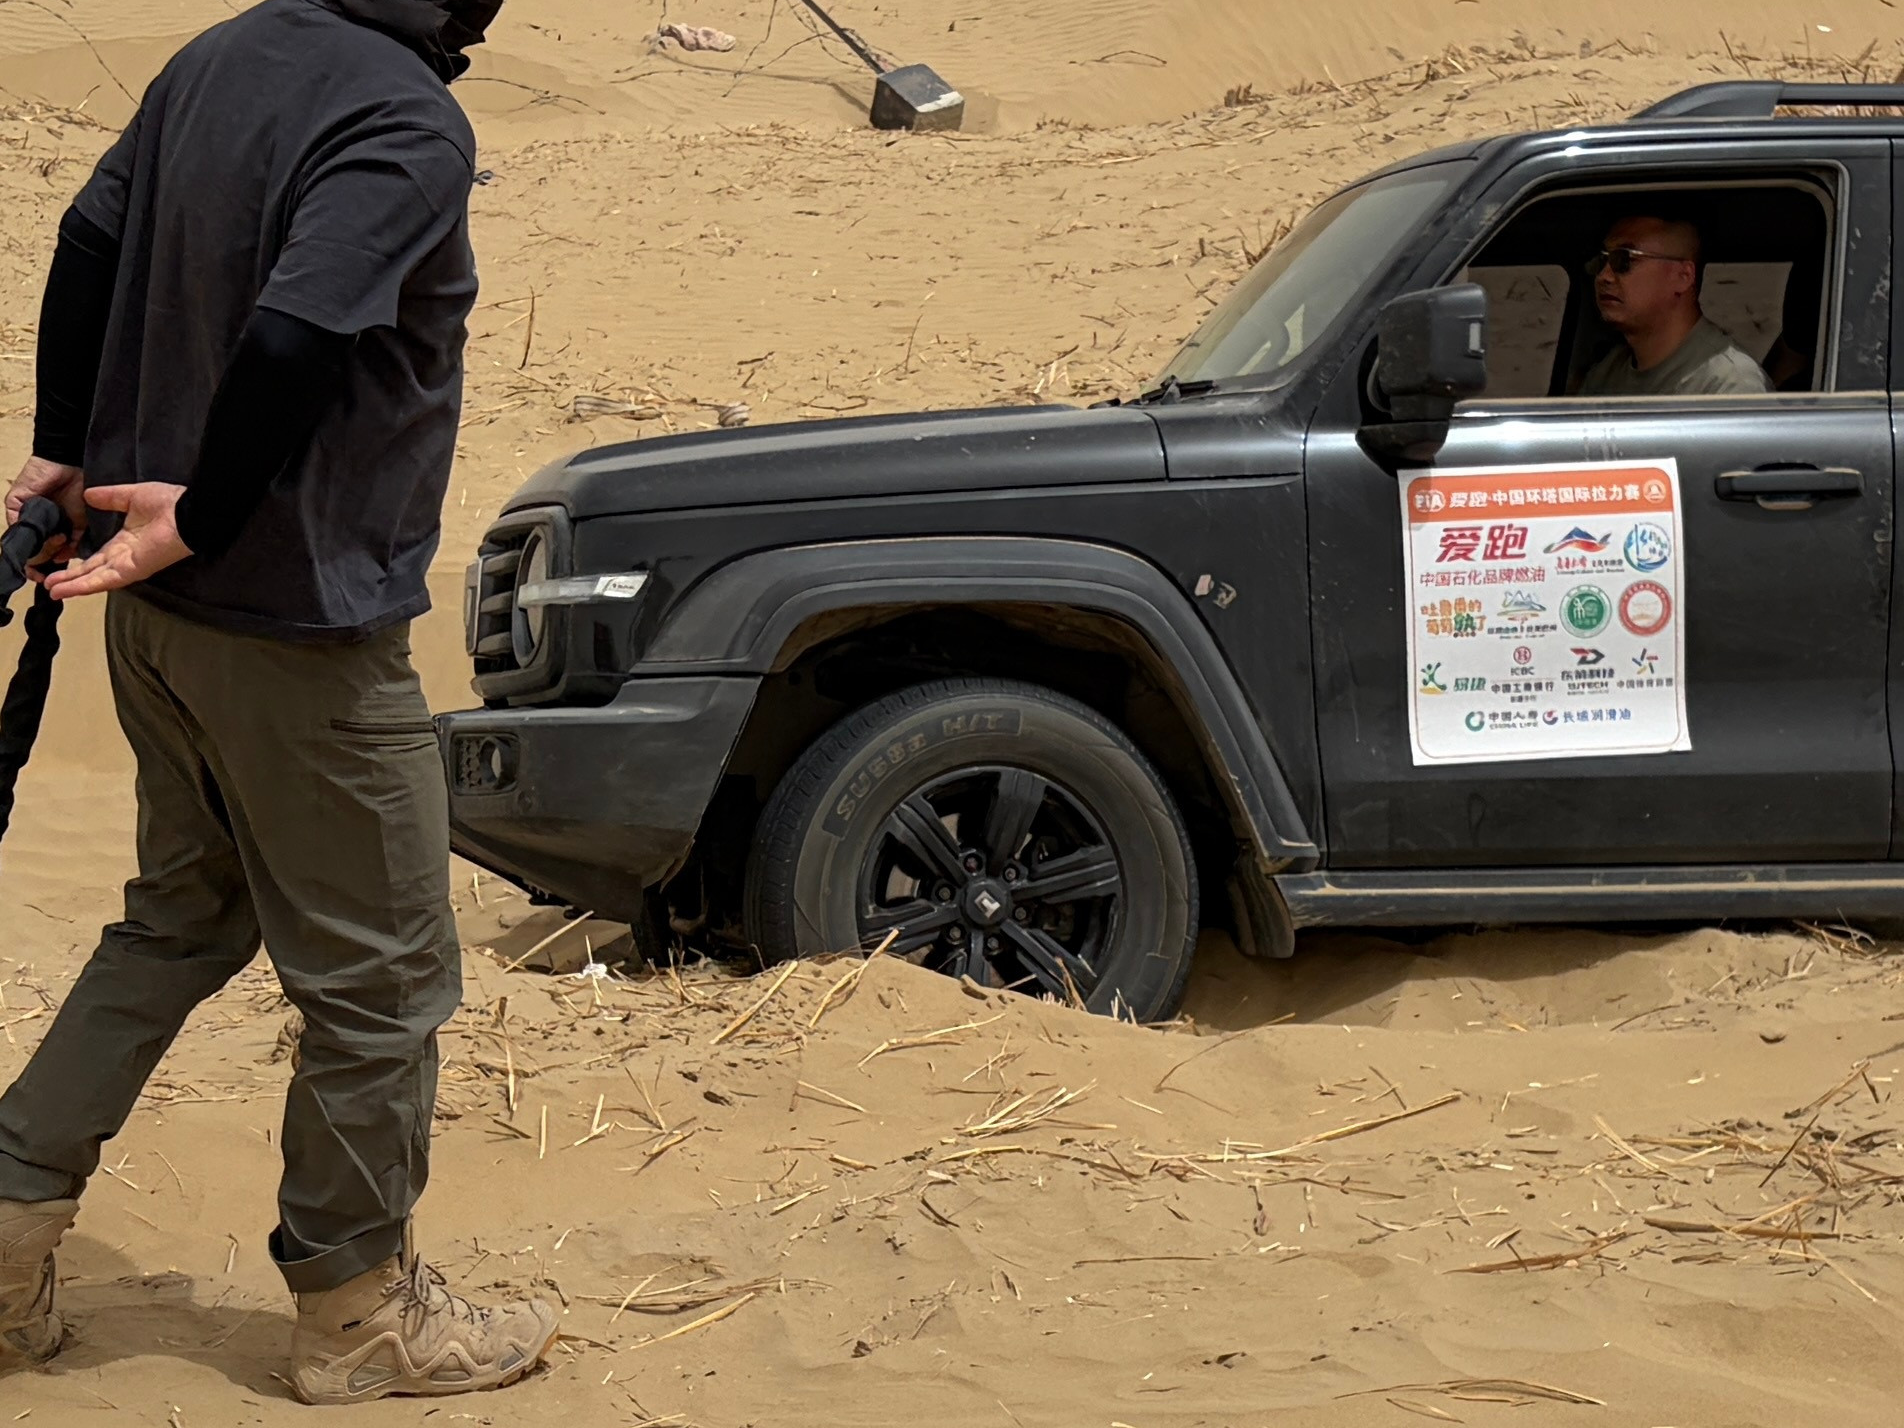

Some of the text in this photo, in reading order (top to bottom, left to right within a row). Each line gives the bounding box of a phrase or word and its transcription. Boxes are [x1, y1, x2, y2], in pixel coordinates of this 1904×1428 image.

[1435, 523, 1528, 562] 爱跑
[1420, 566, 1545, 587] 中国石化品牌燃油
